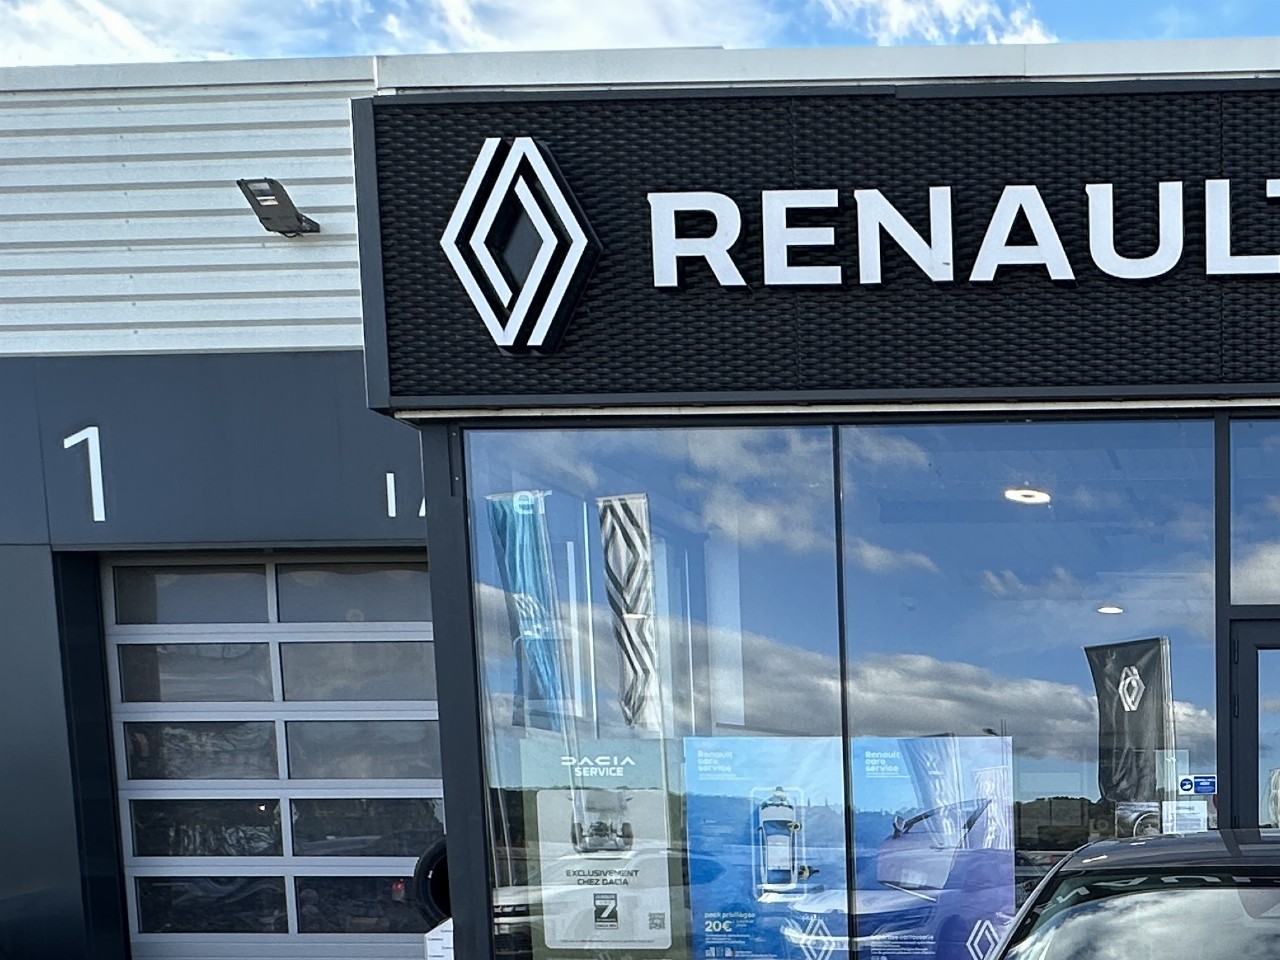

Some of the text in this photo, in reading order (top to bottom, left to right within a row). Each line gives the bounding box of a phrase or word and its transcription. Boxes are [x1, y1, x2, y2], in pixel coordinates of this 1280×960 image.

[63, 426, 106, 522] 1
[560, 755, 636, 766] DACIA
[574, 767, 624, 777] SERVICE
[704, 920, 733, 932] 20€
